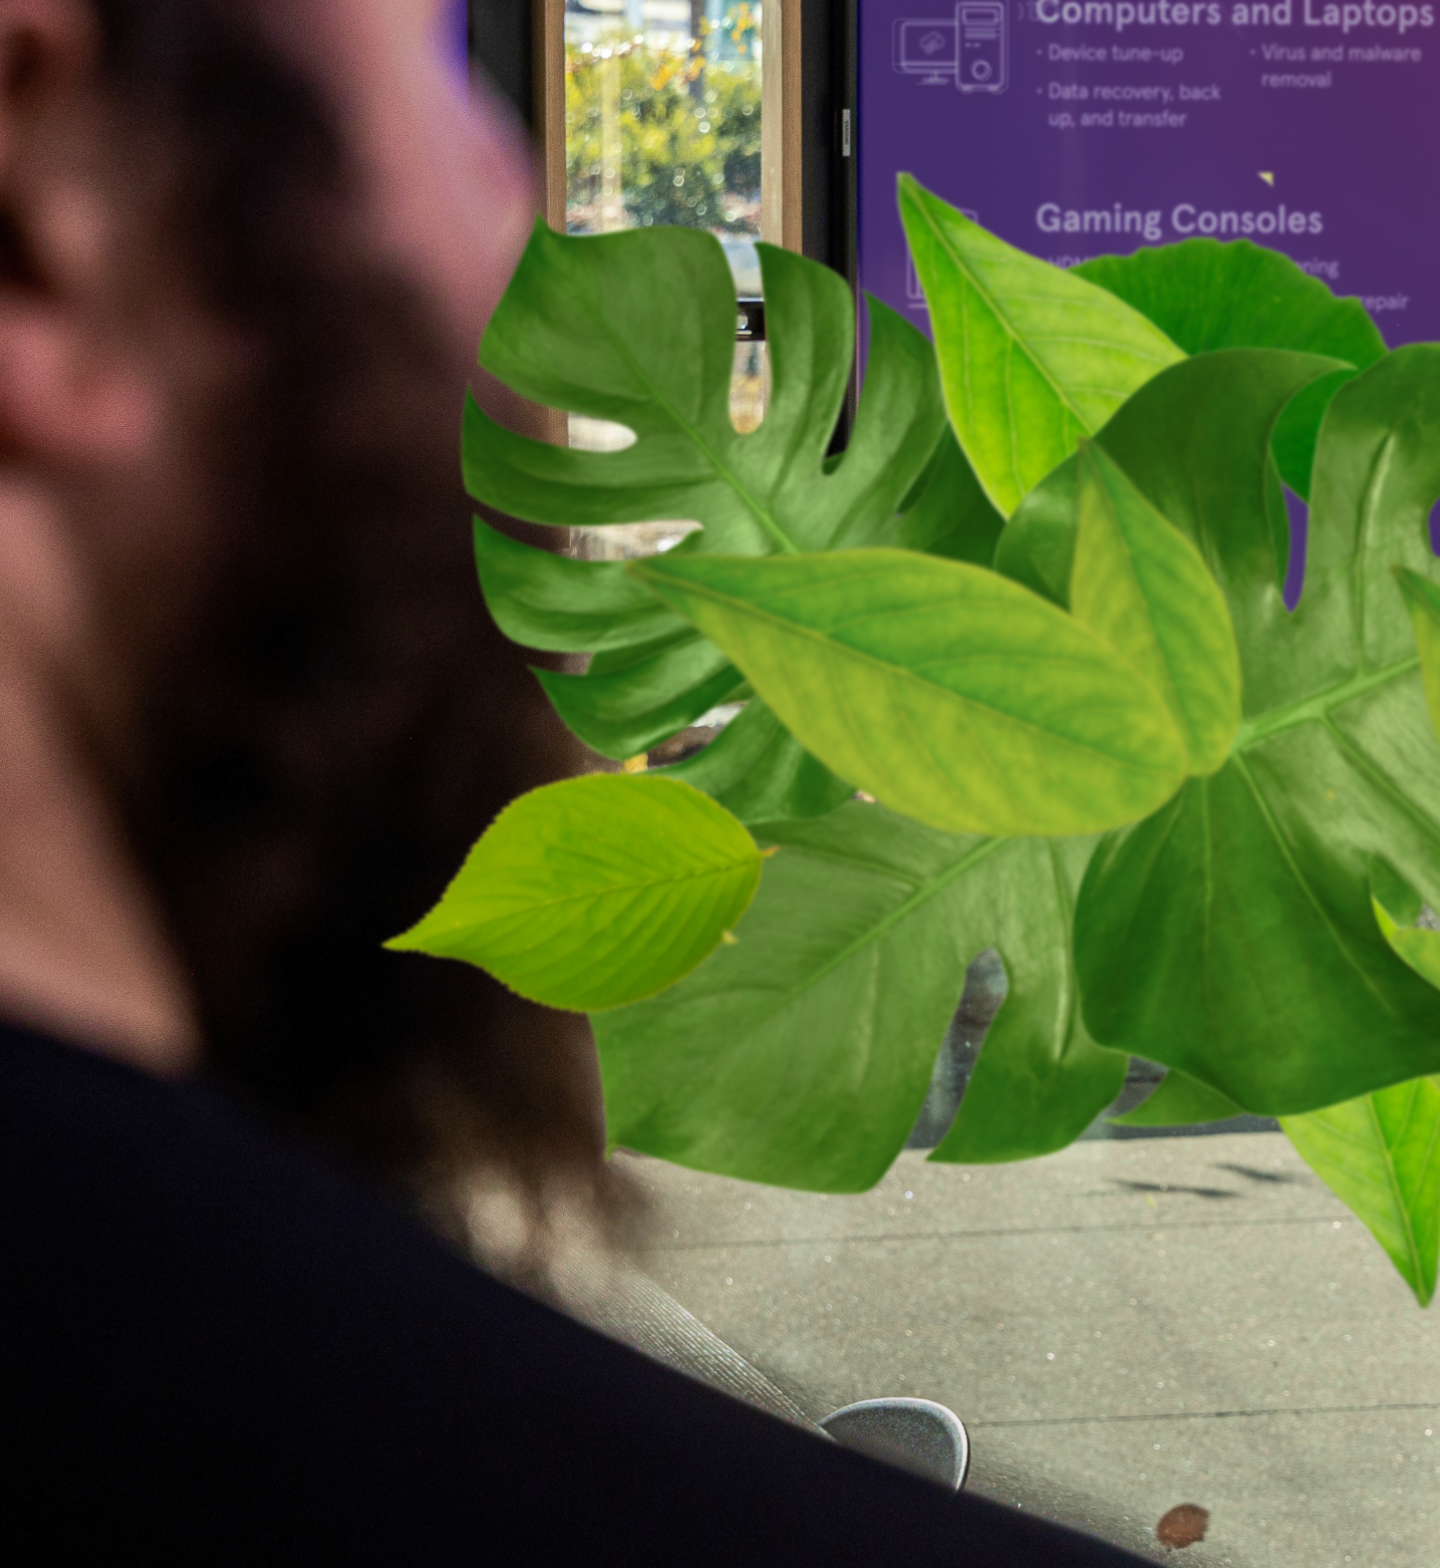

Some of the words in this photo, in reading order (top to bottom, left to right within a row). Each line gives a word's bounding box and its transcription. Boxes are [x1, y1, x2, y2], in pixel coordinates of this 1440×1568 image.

[1035, 0, 1222, 32] Computers
[1231, 0, 1292, 26] and
[1303, 0, 1435, 34] Laptops
[1048, 43, 1108, 62] Device
[1111, 45, 1184, 66] tune-up
[1261, 44, 1306, 62] Virus
[1310, 44, 1344, 62] and
[1348, 44, 1423, 62] malware
[1261, 71, 1332, 88] removal
[1048, 82, 1090, 100] Data
[1093, 85, 1175, 104] recovery,
[1178, 83, 1222, 100] back
[1048, 112, 1076, 130] up,
[1080, 110, 1114, 127] and
[1117, 110, 1187, 127] transfer
[1035, 203, 1163, 241] Gaming
[1171, 203, 1324, 234] Consoles
